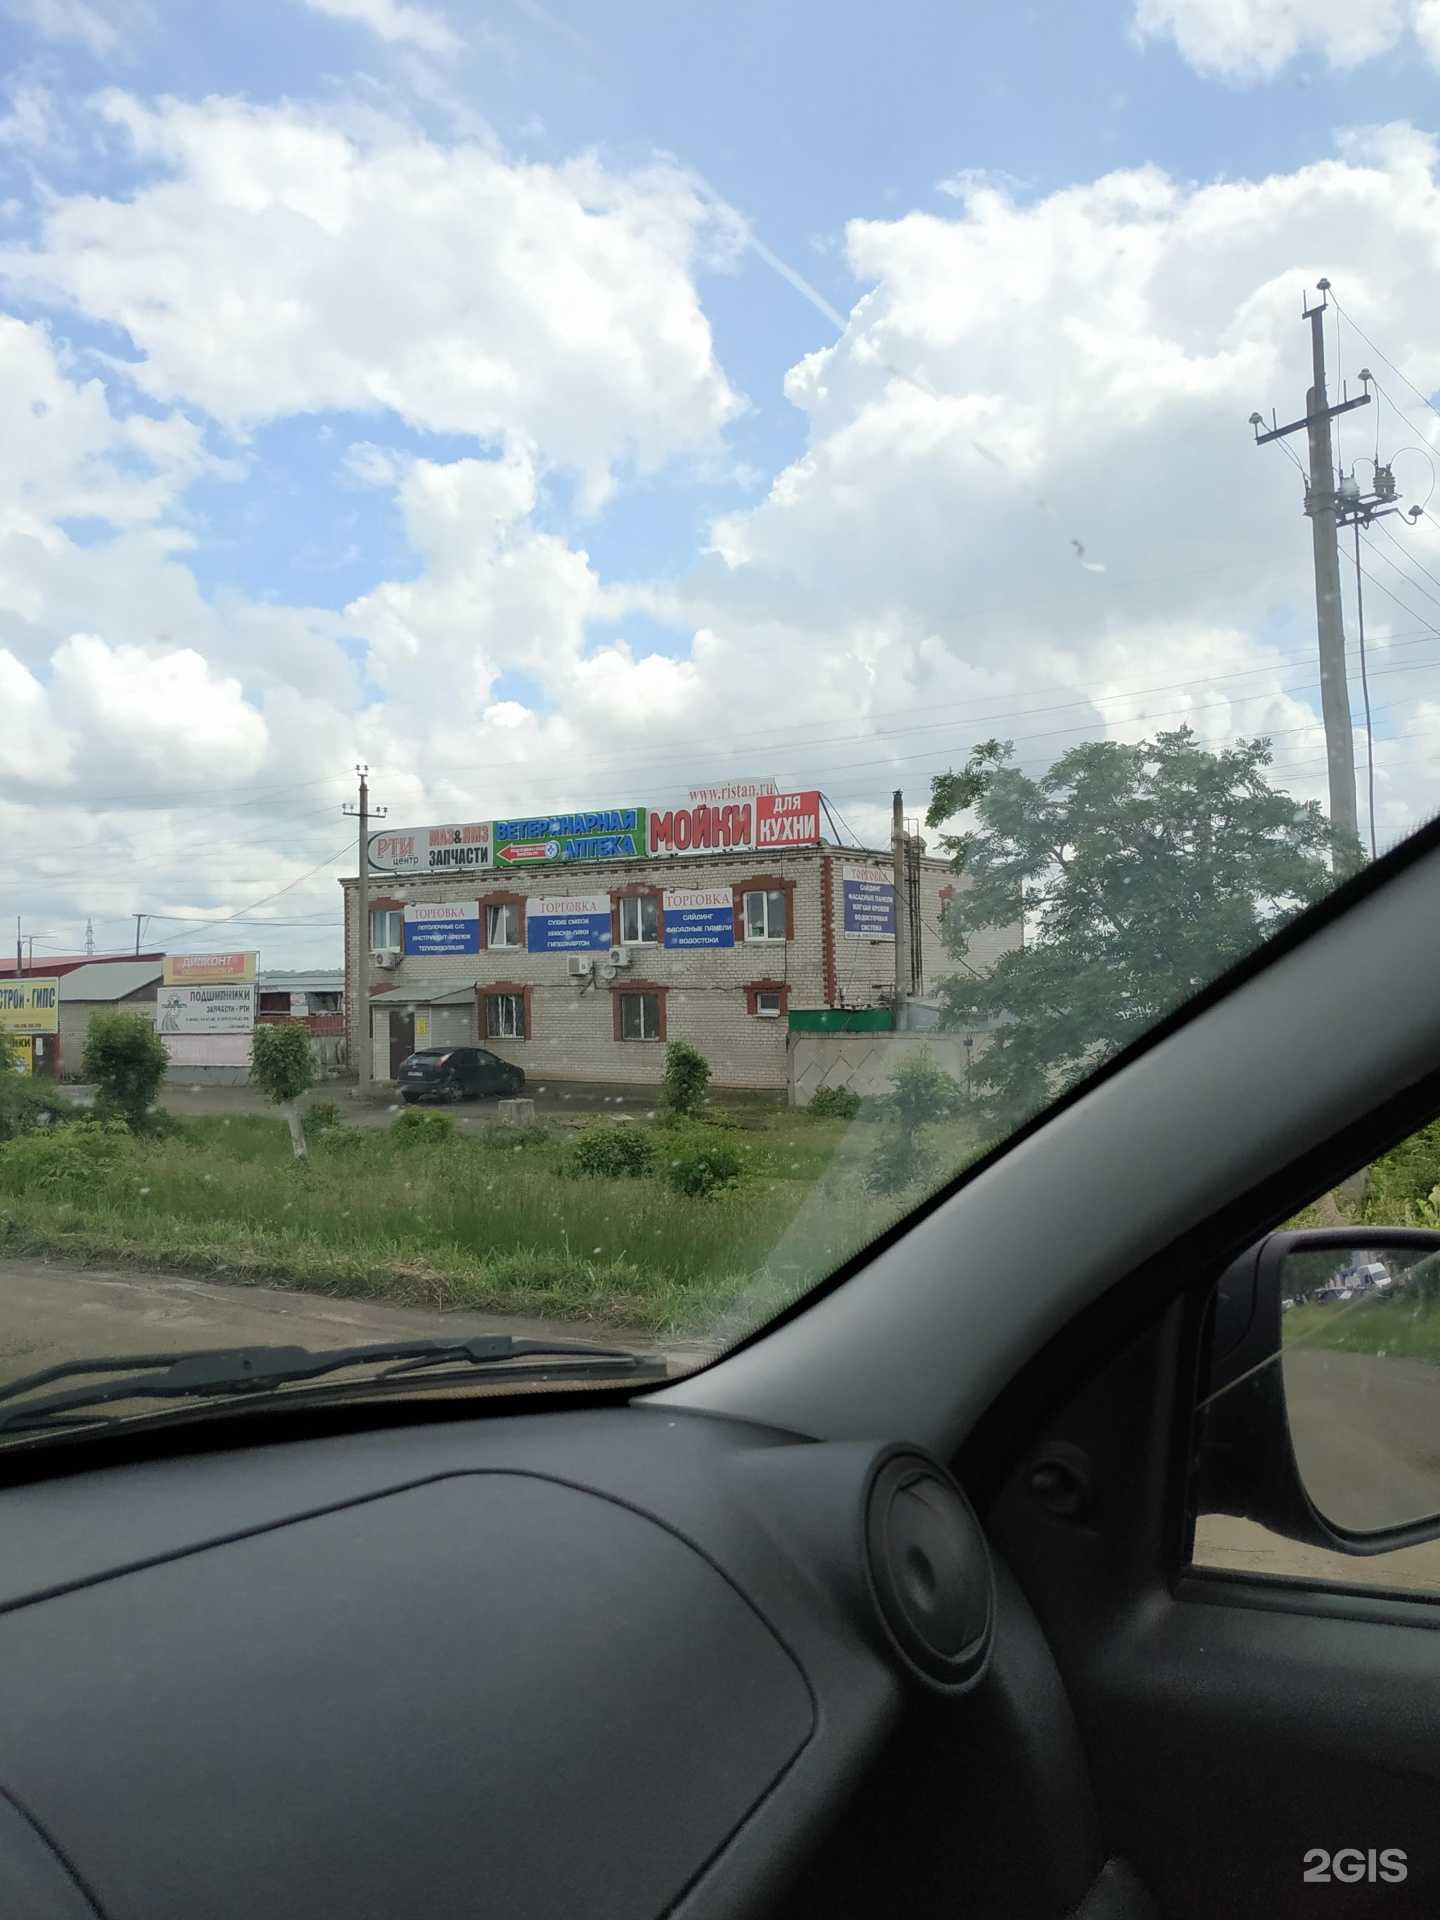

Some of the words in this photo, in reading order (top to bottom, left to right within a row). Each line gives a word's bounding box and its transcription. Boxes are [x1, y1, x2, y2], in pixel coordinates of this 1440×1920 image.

[689, 783, 773, 801] www.ristan.ru
[773, 797, 801, 814] ДЛЯ
[650, 804, 752, 852] МОЙКИ
[760, 815, 815, 842] КУХНИ
[376, 837, 416, 858] РТИ
[564, 834, 637, 861] АПТЕКА
[393, 856, 419, 866] центр
[428, 847, 488, 867] ЗАПЧАСТИ
[540, 901, 598, 914] ТОРГОВКА
[667, 893, 730, 907] ТОРГОВКА
[415, 907, 465, 920] ТОРГОВКА
[32, 987, 56, 1009] ГИПС
[190, 990, 250, 1002] ПОДШИПНИКИ
